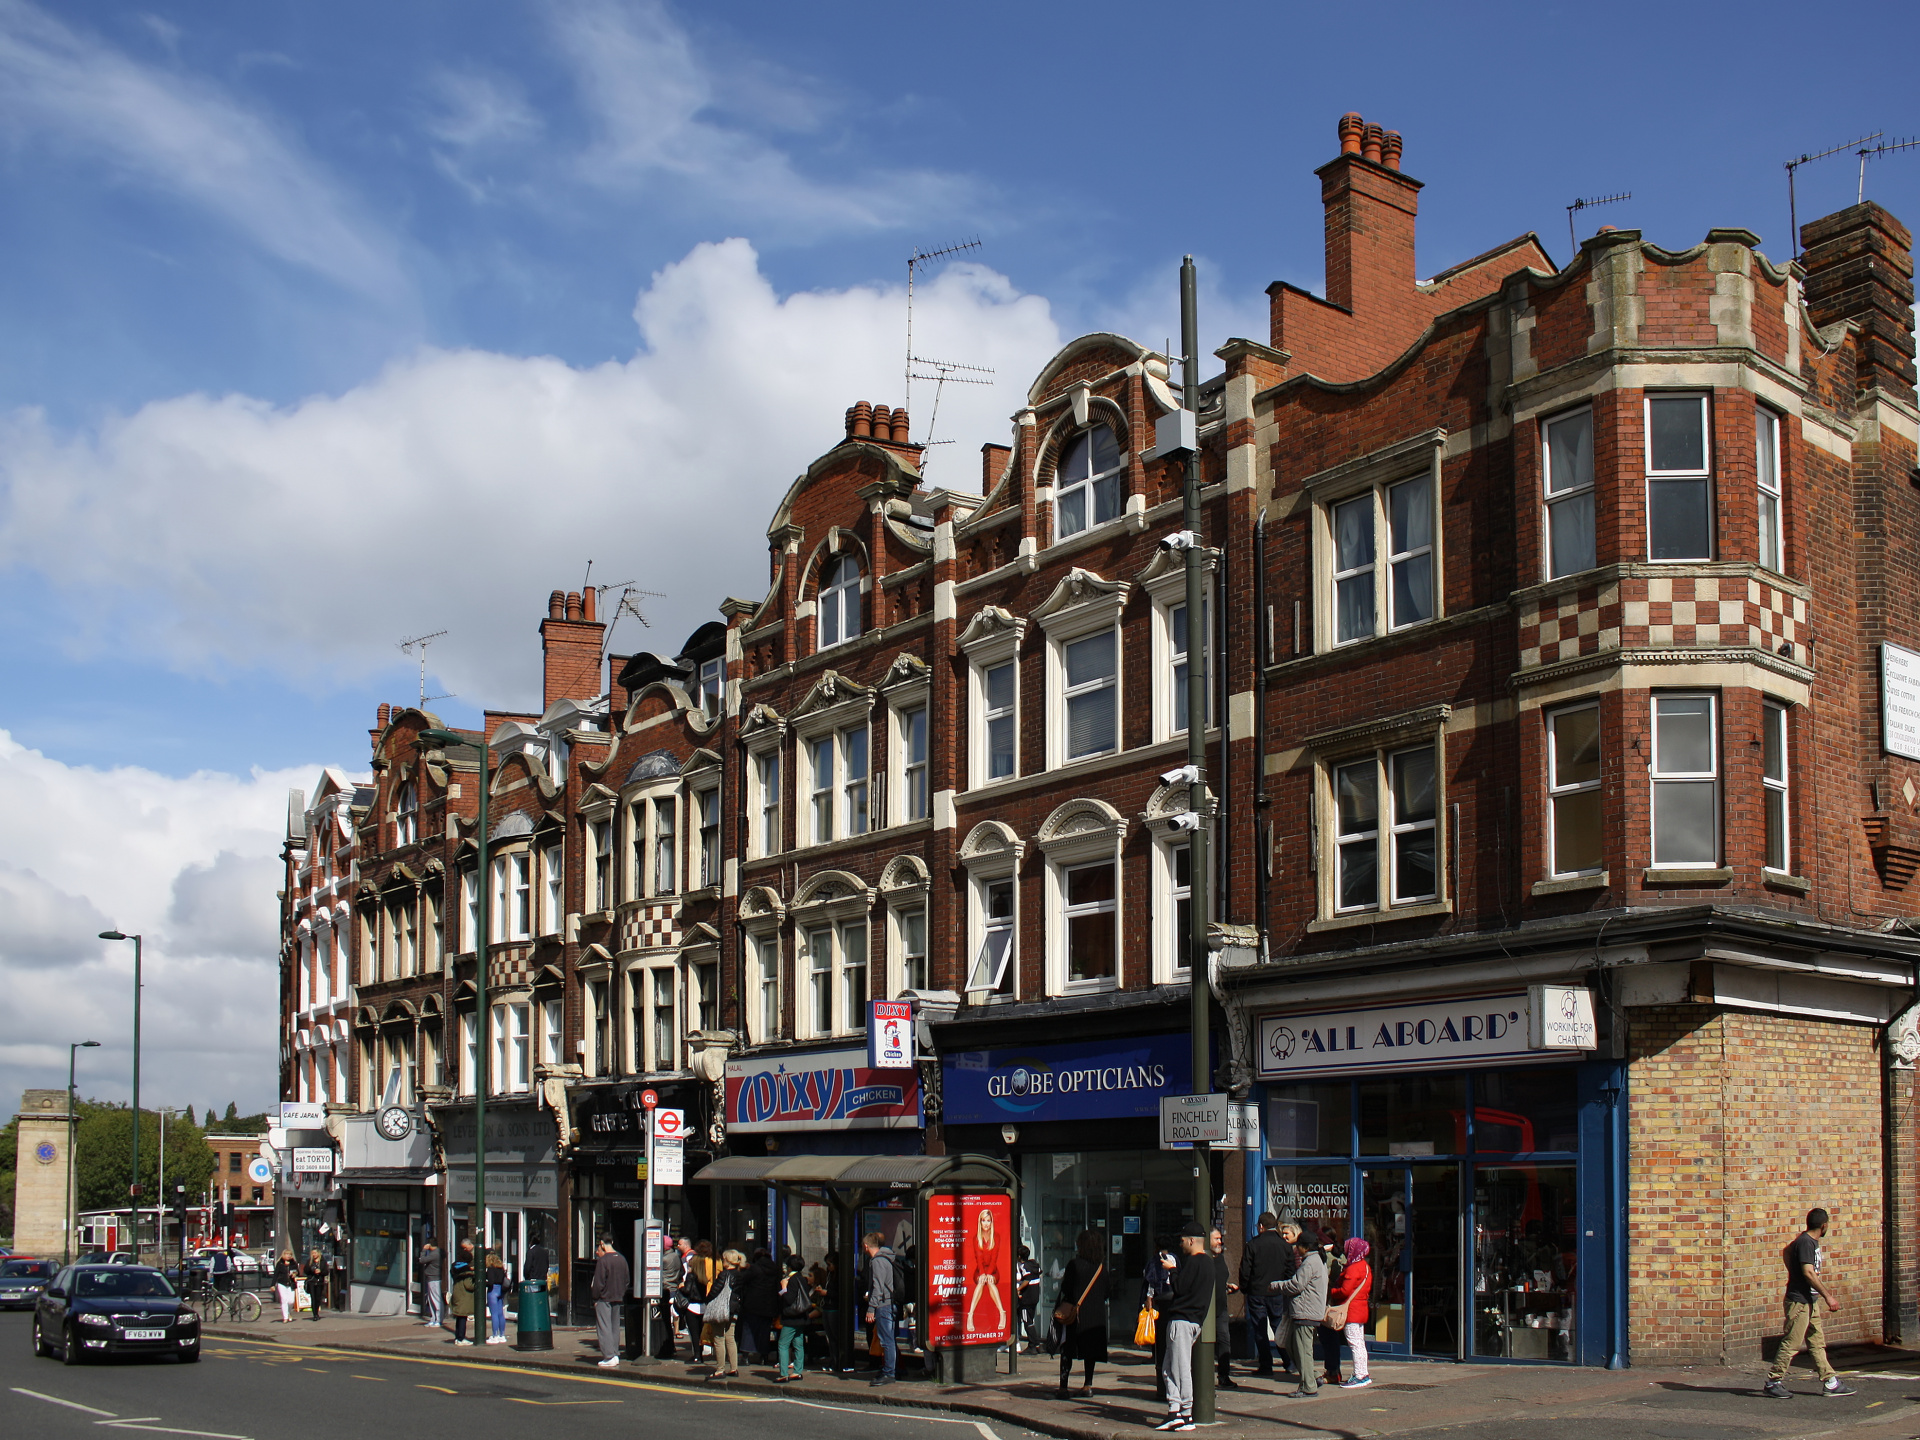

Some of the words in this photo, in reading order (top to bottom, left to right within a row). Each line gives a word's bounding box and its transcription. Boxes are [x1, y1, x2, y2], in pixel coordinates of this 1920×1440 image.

[877, 1004, 908, 1016] DIXY
[1547, 1022, 1578, 1032] WORKING
[1580, 1023, 1593, 1032] FOR
[1558, 1035, 1585, 1044] CHARITY
[987, 1068, 1053, 1097] GLOBE
[1058, 1064, 1165, 1093] OPTICIANS
[645, 1095, 656, 1103] GL
[852, 1090, 897, 1105] CHICKEN
[1172, 1110, 1219, 1124] FINCHLEY
[508, 1121, 529, 1137] SONS
[1172, 1127, 1200, 1139] ROAD
[1271, 1184, 1282, 1193] WE
[1283, 1184, 1305, 1193] WILL
[1307, 1184, 1349, 1193] COLLECT
[1271, 1196, 1296, 1205] YOUR
[1300, 1196, 1347, 1205] DONATION
[1285, 1209, 1301, 1218] 020
[1303, 1209, 1324, 1218] 8381
[1326, 1209, 1347, 1218] 1717
[933, 1274, 966, 1285] Home
[934, 1285, 967, 1298] Again
[966, 1331, 997, 1339] SEPTEMBER
